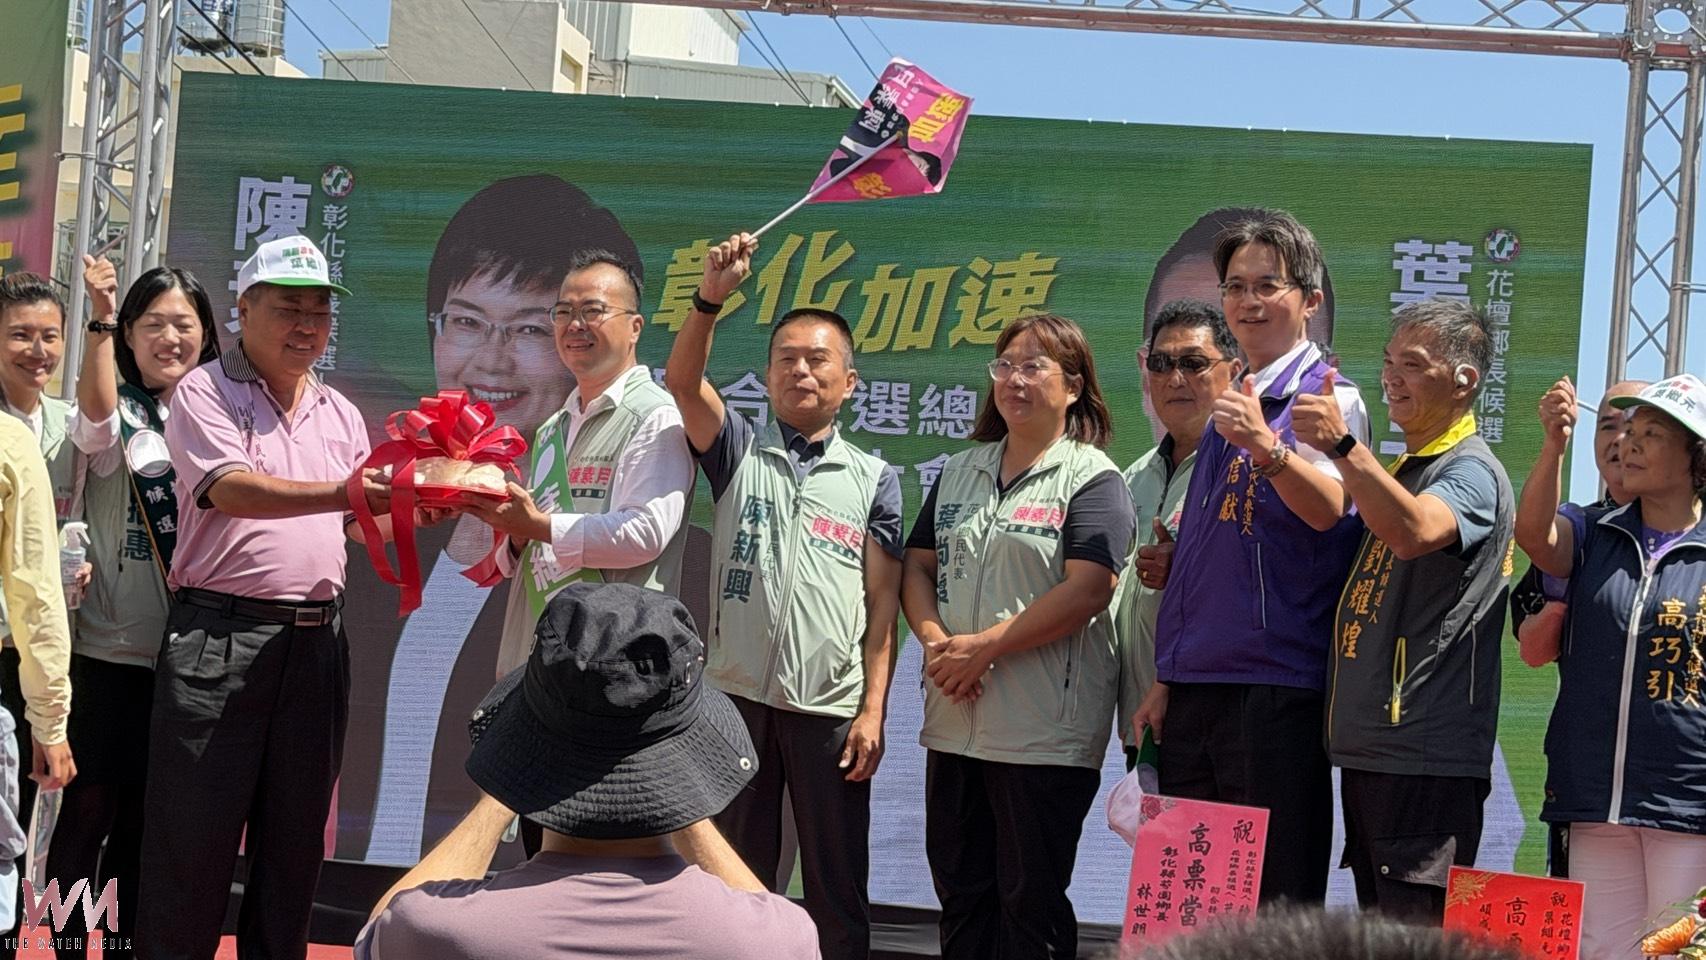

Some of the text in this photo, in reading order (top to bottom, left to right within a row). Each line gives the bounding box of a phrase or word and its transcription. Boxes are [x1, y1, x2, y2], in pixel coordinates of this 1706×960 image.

[722, 494, 774, 604] 陳新興
[1647, 599, 1688, 702] 高巧引
[1178, 822, 1212, 927] 高票當
[1233, 819, 1256, 844] 祝
